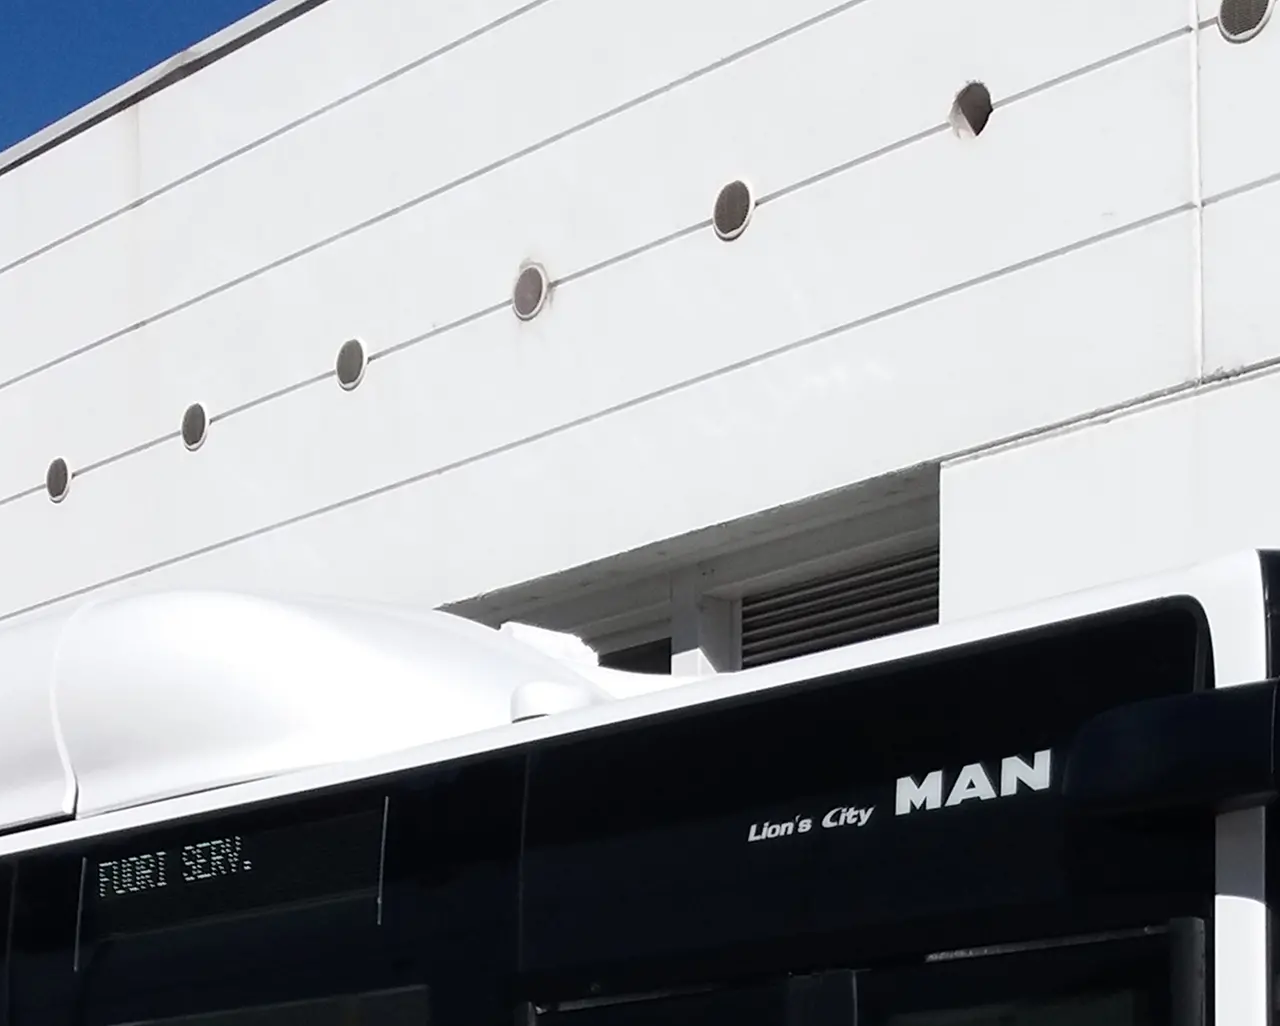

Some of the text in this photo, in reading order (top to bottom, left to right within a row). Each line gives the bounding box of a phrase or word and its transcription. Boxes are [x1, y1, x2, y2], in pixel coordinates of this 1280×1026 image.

[895, 748, 1052, 816] MAN
[748, 805, 876, 842] Lion's City
[99, 836, 252, 897] FUORI SERV.
